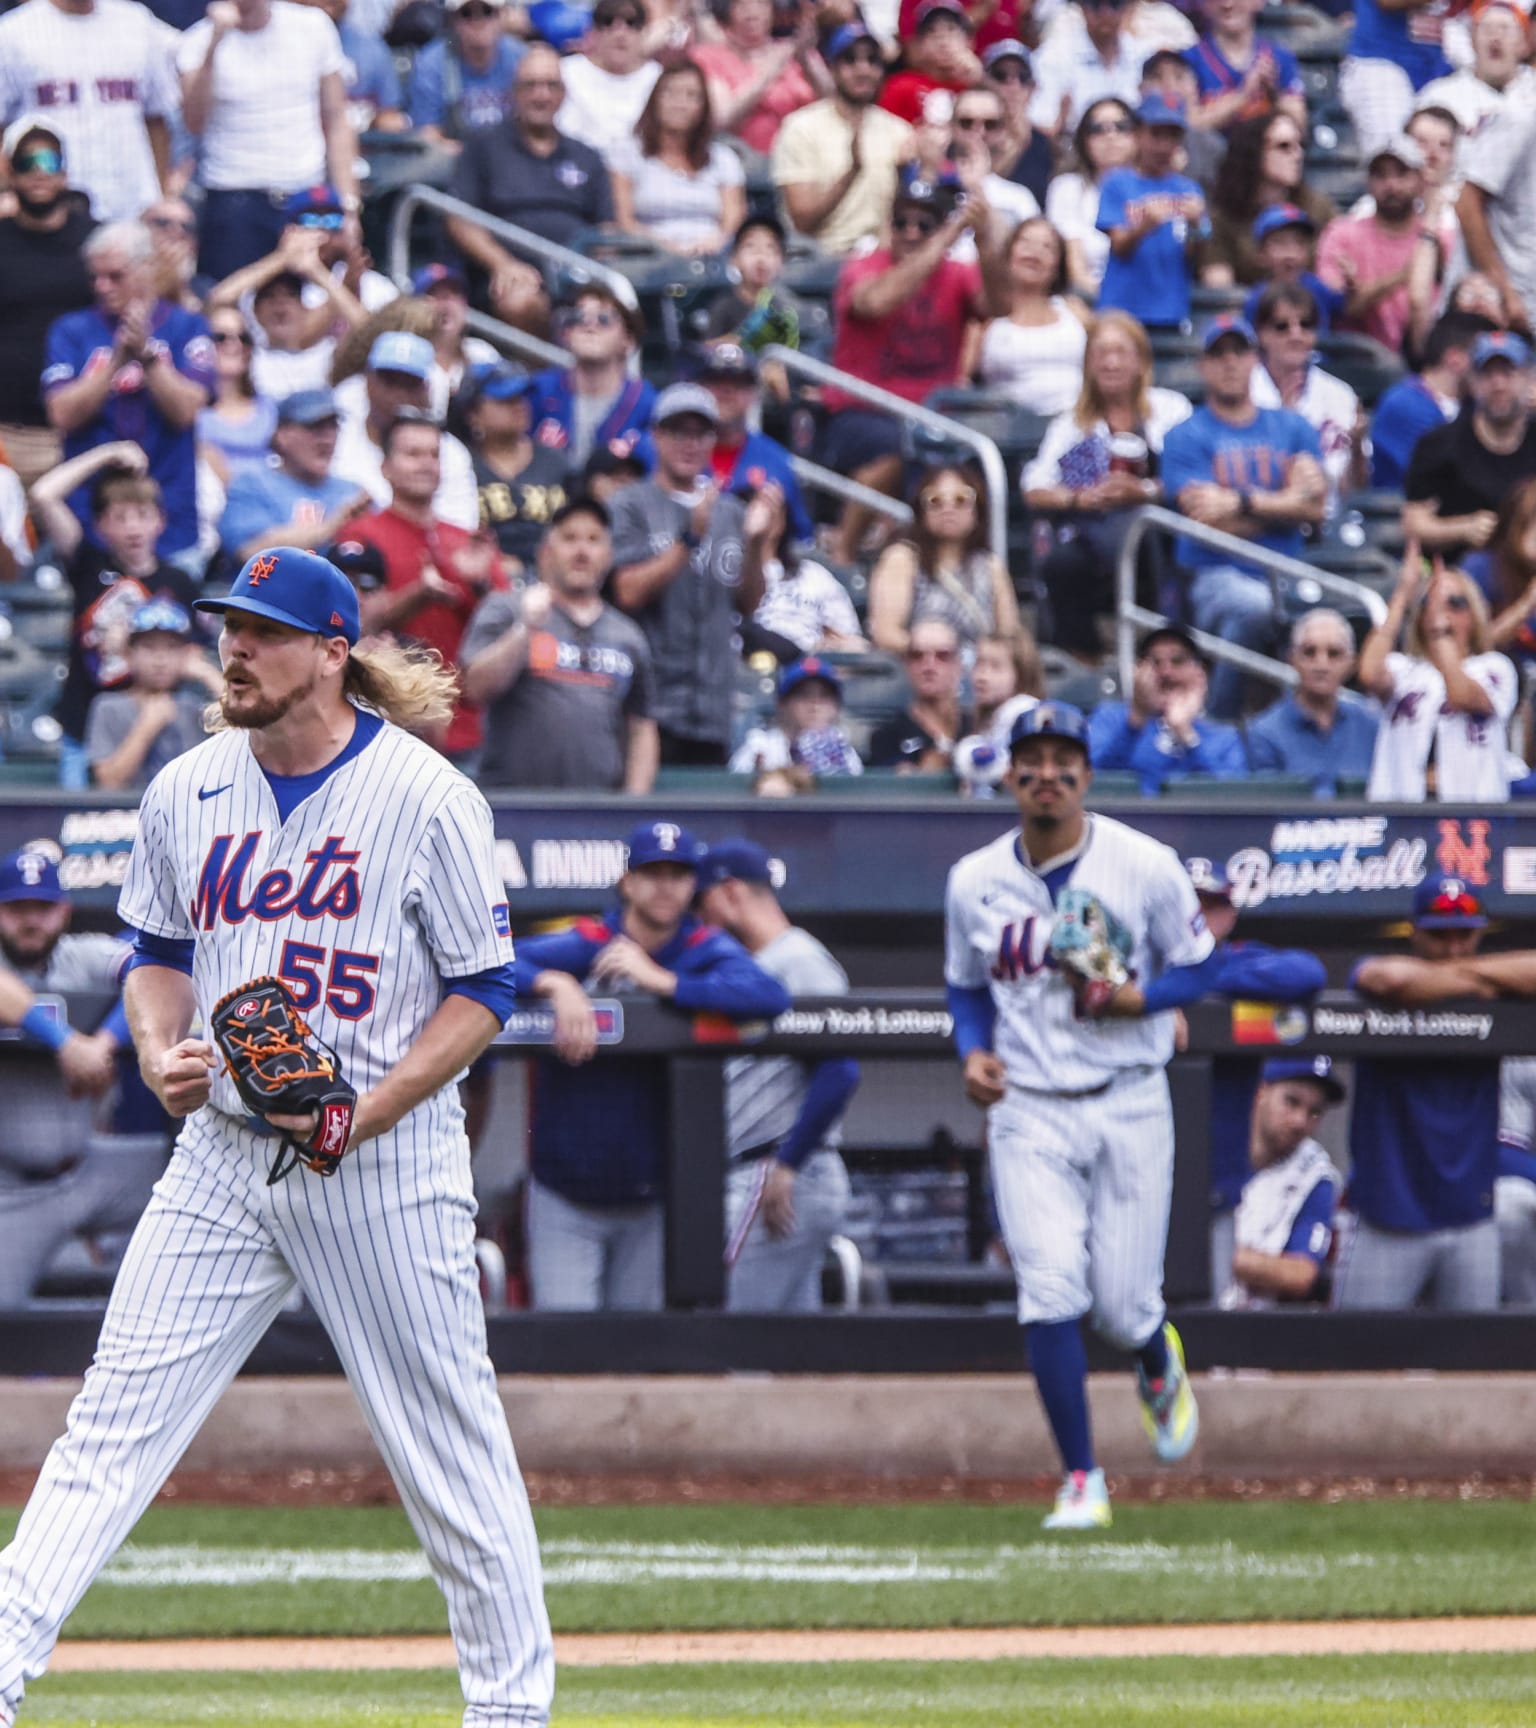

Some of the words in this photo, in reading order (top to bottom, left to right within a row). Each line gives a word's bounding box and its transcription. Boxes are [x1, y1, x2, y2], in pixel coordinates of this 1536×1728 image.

[1270, 816, 1388, 851] MORE
[190, 830, 362, 931] Mets
[1226, 838, 1427, 908] Baseball
[276, 939, 380, 1023] 55
[773, 1009, 825, 1034] New
[826, 1008, 876, 1034] York
[876, 1008, 955, 1037] Lottery
[1314, 1008, 1364, 1035] New
[1366, 1008, 1413, 1035] York
[1414, 1009, 1493, 1040] Lottery
